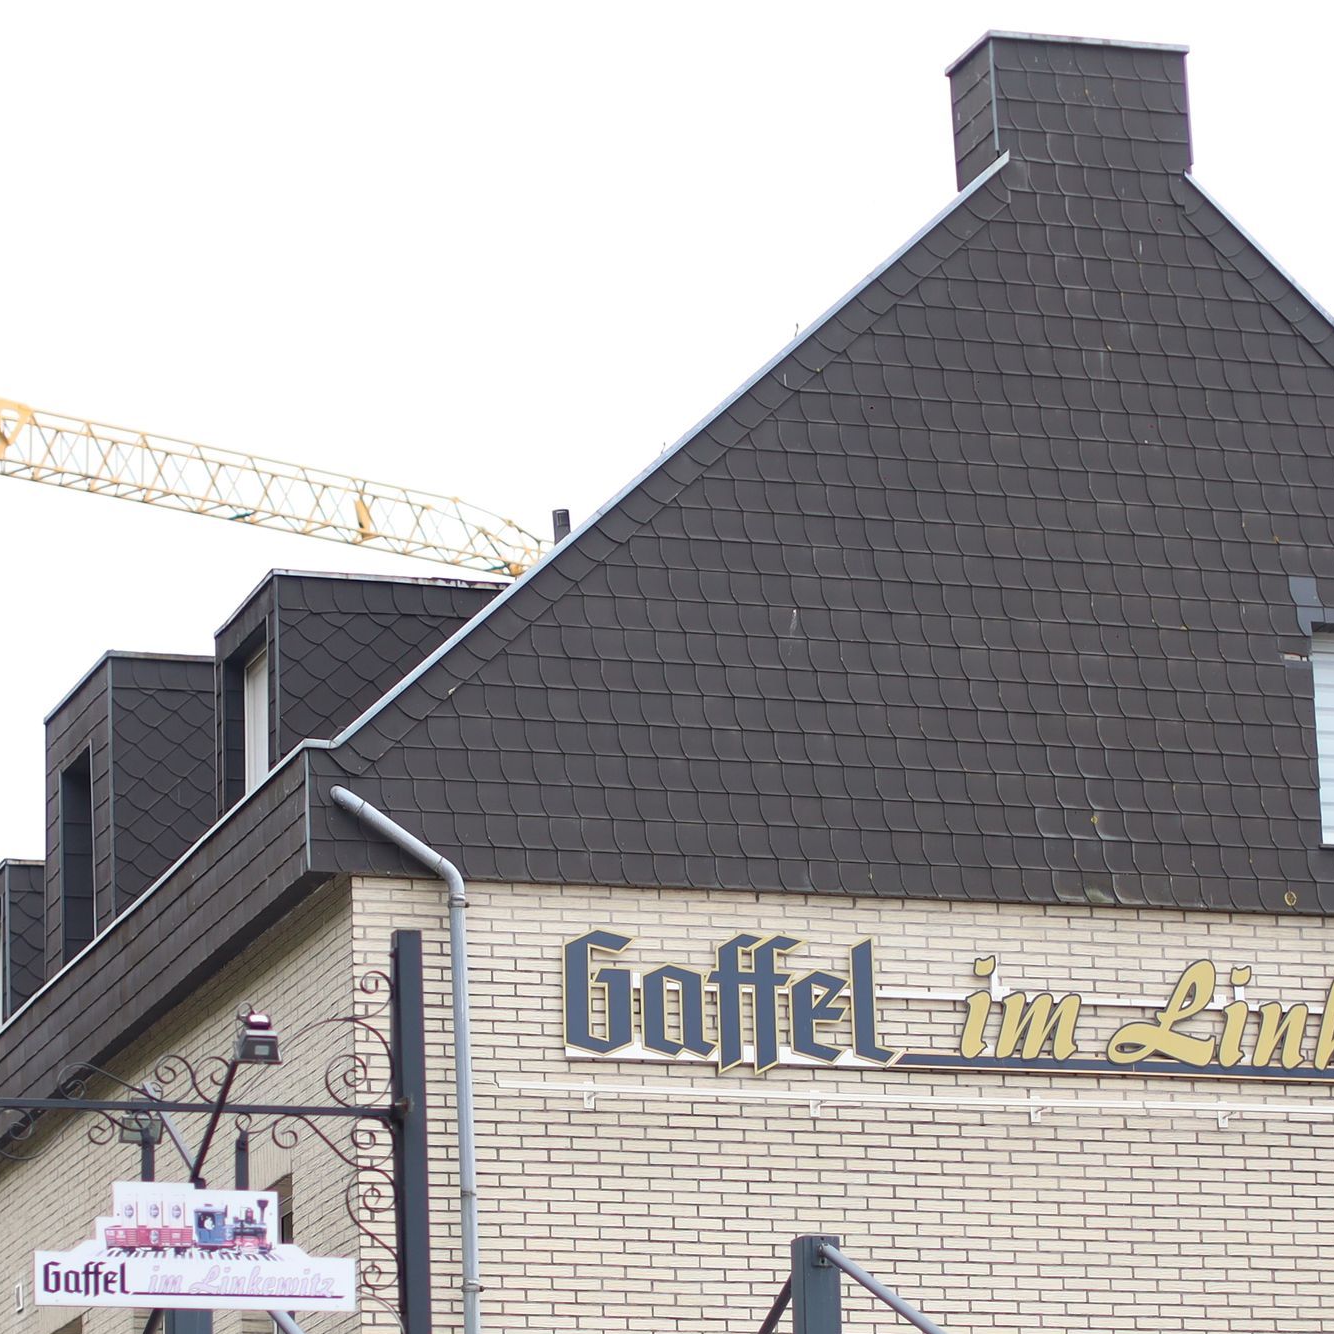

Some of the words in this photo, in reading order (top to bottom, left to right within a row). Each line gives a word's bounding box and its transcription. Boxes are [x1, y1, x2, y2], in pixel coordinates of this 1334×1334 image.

[562, 929, 905, 1076] Gaffel
[959, 955, 1082, 1062] im
[43, 1261, 131, 1298] Gaffel
[147, 1265, 182, 1295] im
[188, 1264, 336, 1298] Linkewitz
